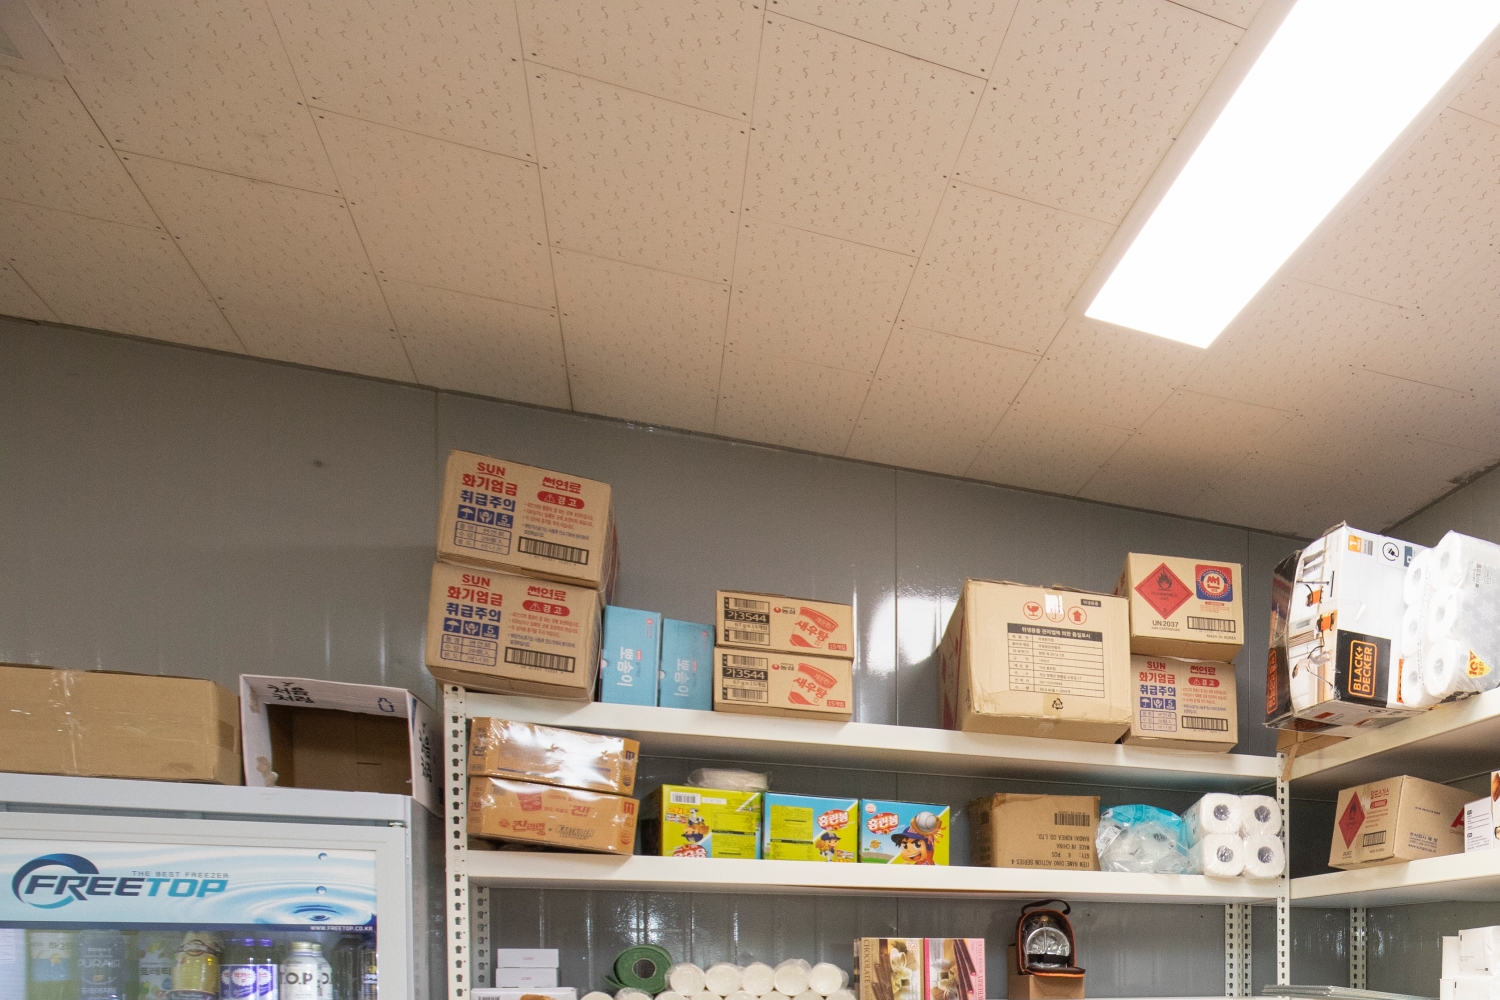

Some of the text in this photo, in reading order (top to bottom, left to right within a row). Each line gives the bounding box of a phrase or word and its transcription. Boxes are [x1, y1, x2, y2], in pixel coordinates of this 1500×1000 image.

[462, 473, 517, 496] 화기엄금
[542, 476, 581, 494] 썬연료
[460, 489, 516, 512] 취급주의
[447, 585, 503, 606] 화기엄금
[527, 586, 566, 601] 썬연료
[446, 602, 501, 622] 취급주의
[1353, 646, 1363, 692] BLACK+
[1362, 646, 1373, 693] DECKER
[867, 816, 898, 832] 홈런볼
[25, 874, 229, 901] FREETOP
